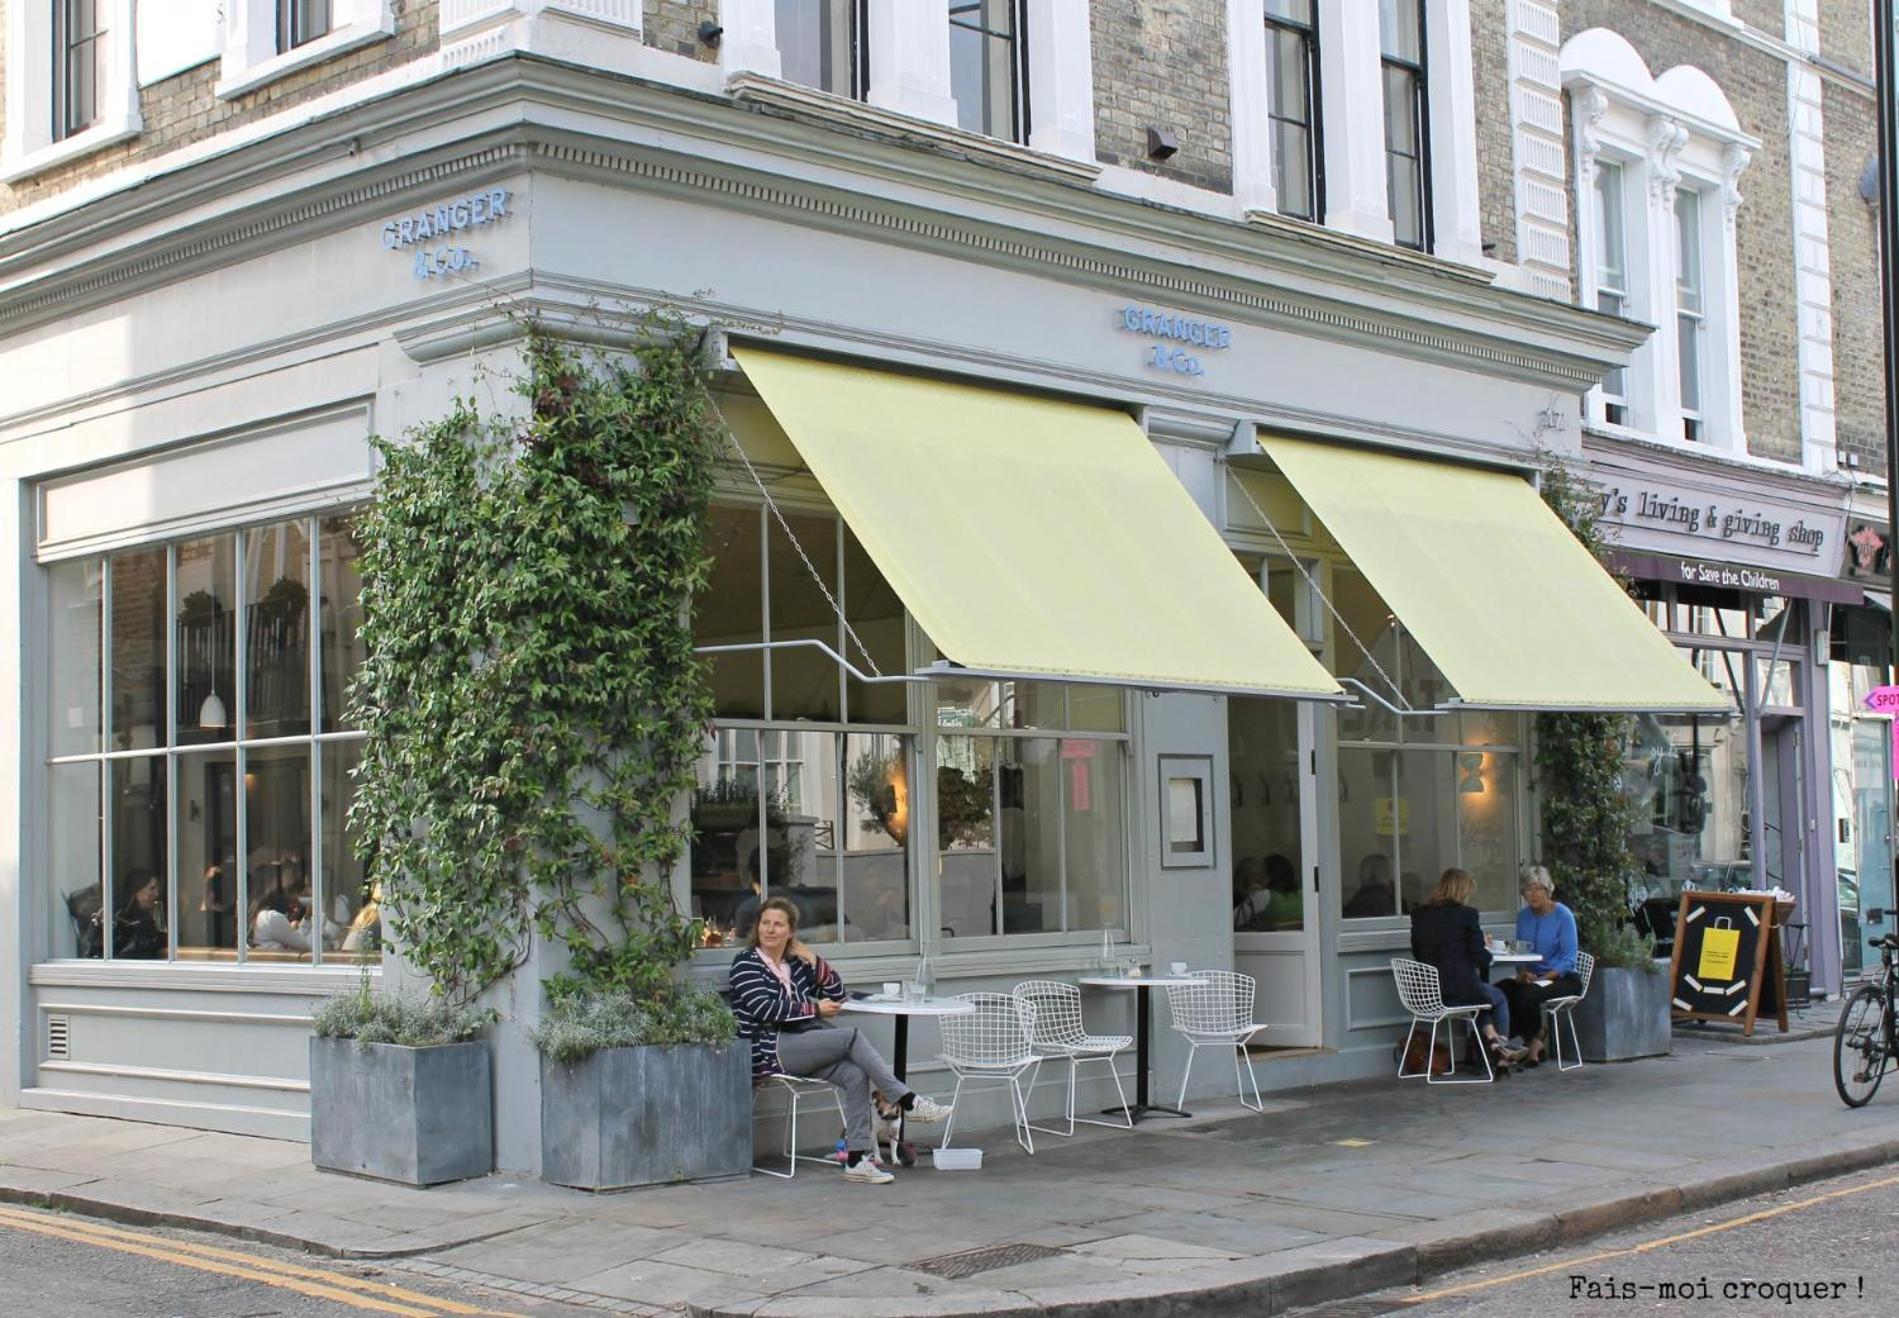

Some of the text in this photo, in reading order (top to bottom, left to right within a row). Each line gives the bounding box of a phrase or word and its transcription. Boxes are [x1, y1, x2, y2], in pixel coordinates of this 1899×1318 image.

[379, 186, 509, 250] GRANGER
[1637, 491, 1699, 532] living
[1706, 504, 1718, 529] &
[1723, 510, 1781, 545] giving
[1788, 519, 1824, 552] shop
[1680, 561, 1780, 592] for Save the Children
